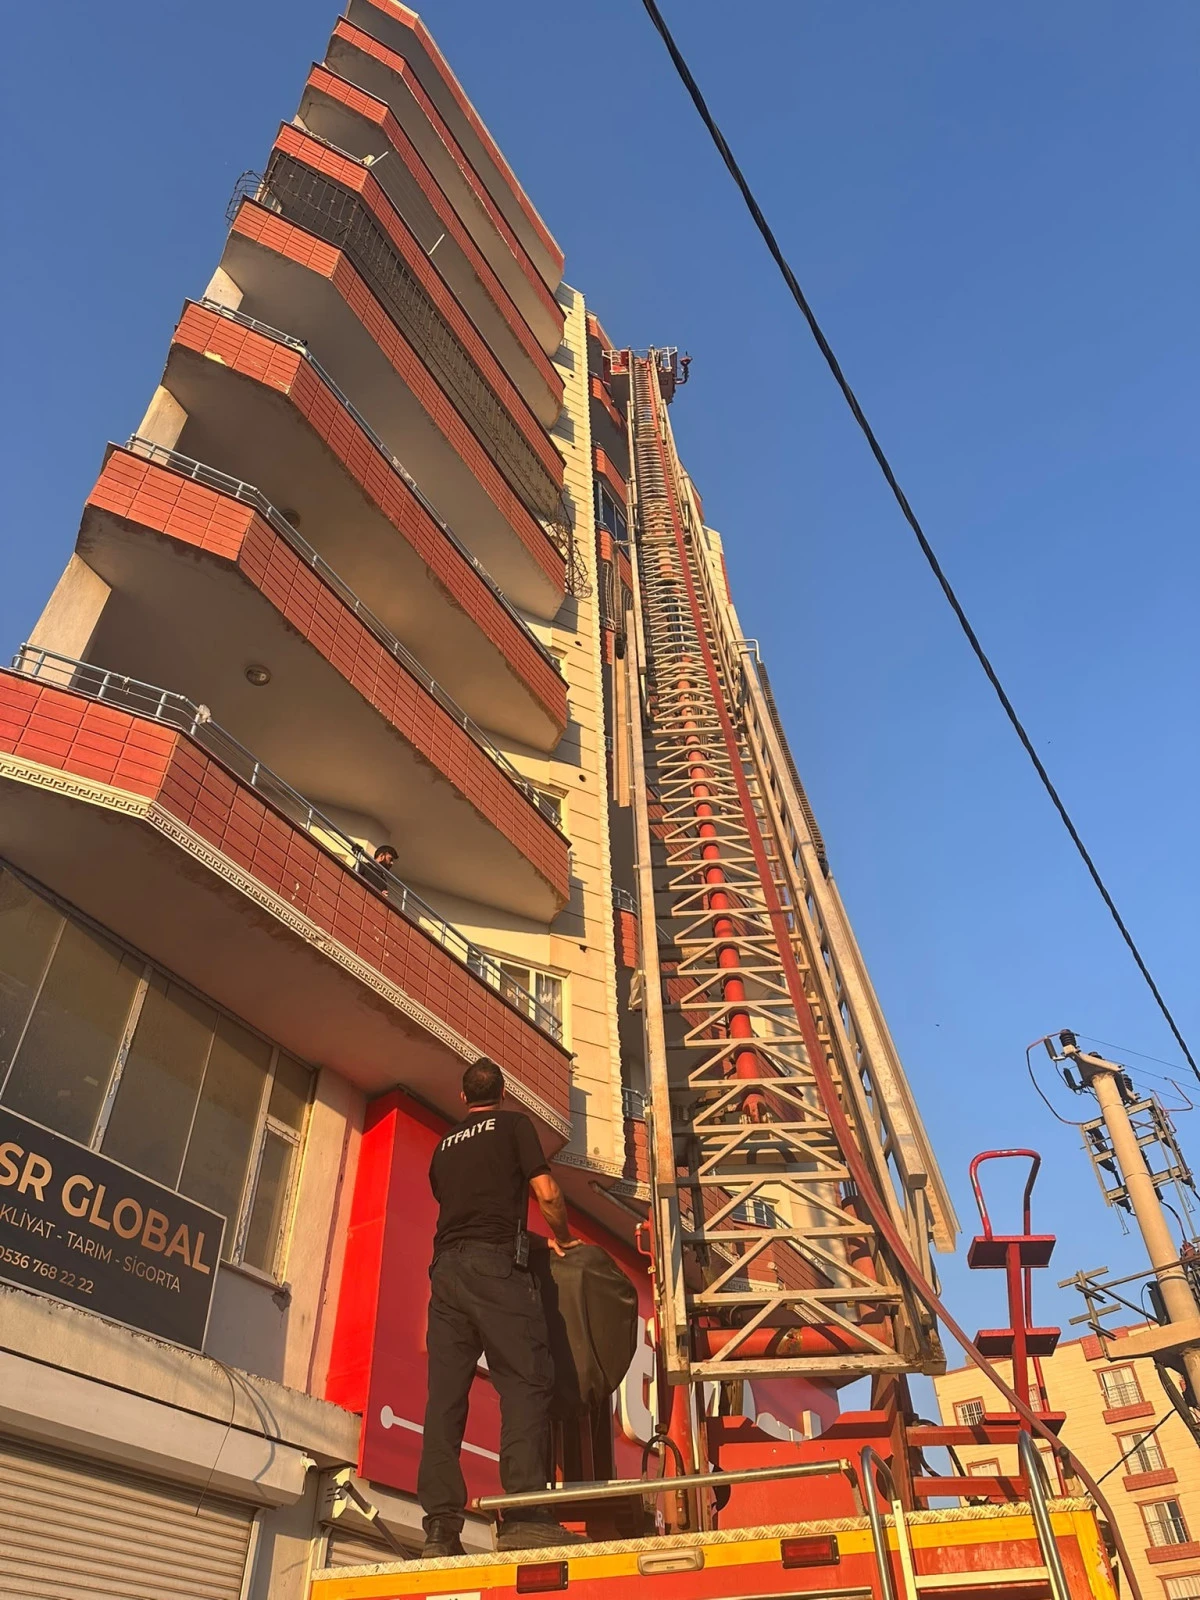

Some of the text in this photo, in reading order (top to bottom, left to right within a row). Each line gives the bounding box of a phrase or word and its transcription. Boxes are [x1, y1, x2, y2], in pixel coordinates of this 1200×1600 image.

[61, 1174, 211, 1275] GLOBAL
[32, 1259, 58, 1280] 768
[59, 1270, 75, 1287] 22
[77, 1277, 94, 1294] 22
[67, 1231, 112, 1264] TARIM
[122, 1255, 181, 1293] SİGORTA
